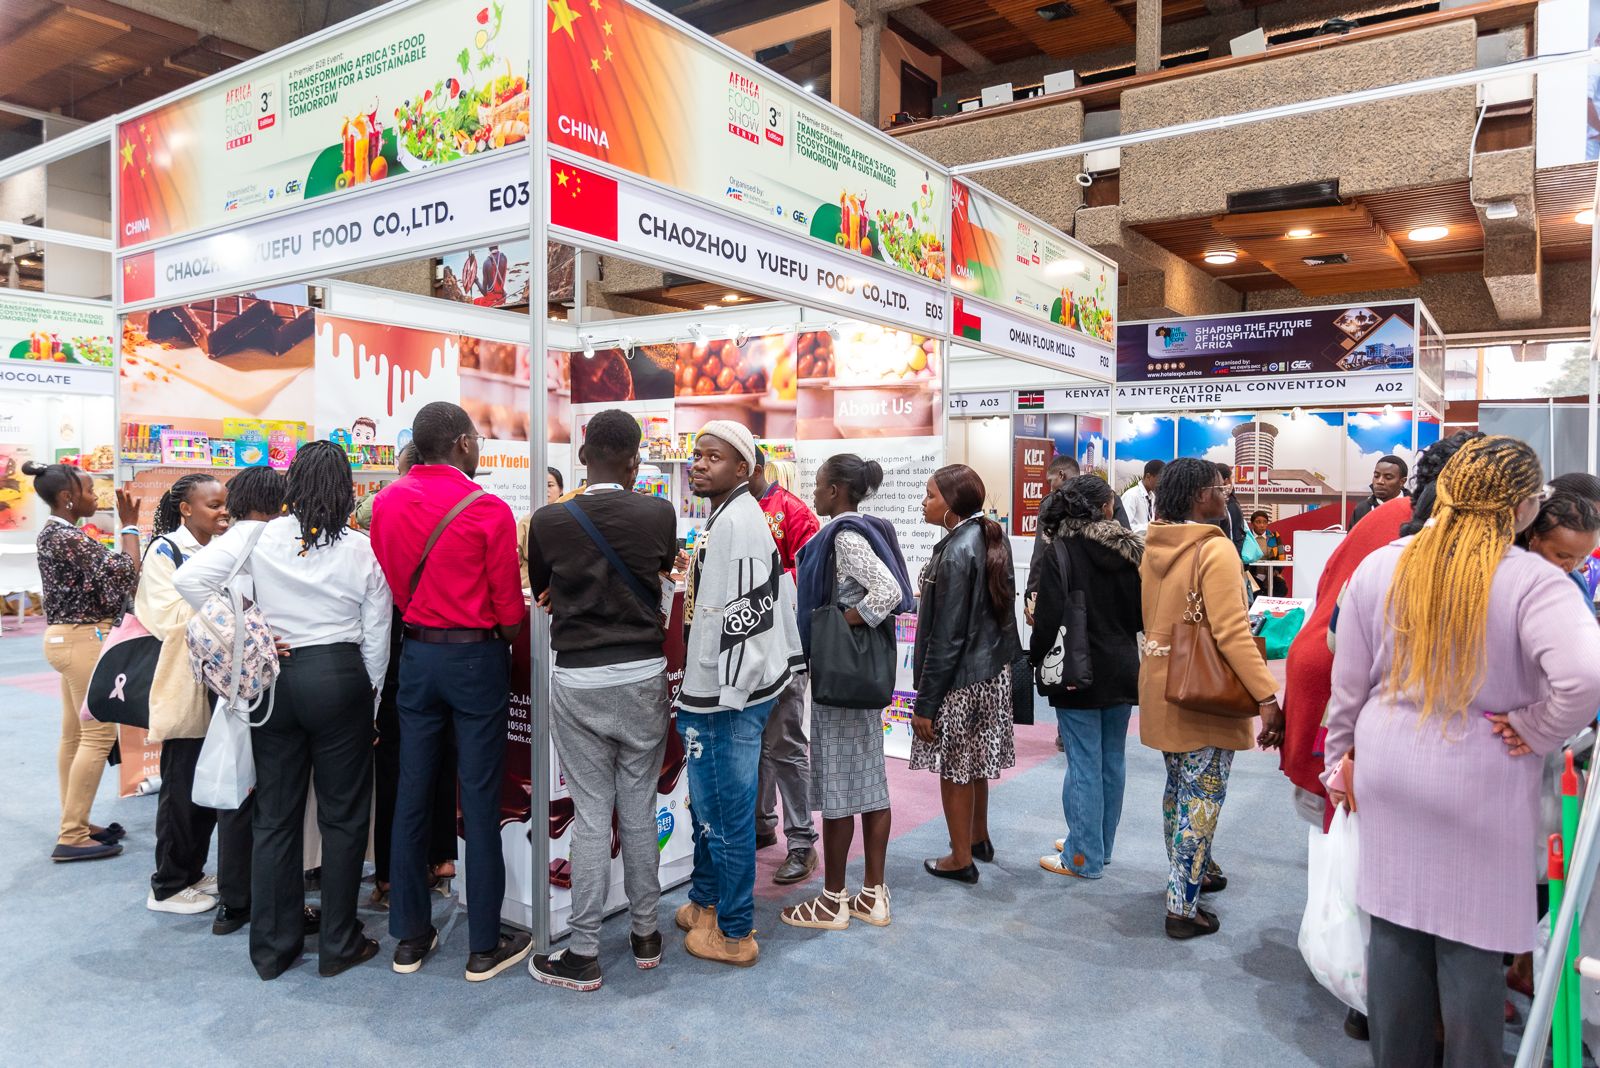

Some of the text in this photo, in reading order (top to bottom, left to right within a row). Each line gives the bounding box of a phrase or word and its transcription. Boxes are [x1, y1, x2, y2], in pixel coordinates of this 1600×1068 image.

[288, 33, 426, 94] TRANSFORMING AFRICA'S FOOD
[288, 46, 427, 107] ECOSYSTEM FOR A SUSTAINABLE
[729, 71, 760, 99] AFRICA
[226, 83, 252, 105] AFRICA
[728, 88, 760, 116] FOOD
[288, 92, 339, 118] TOMORROW
[728, 106, 760, 133] SHOW
[557, 114, 610, 150] CHINA
[729, 123, 760, 145] KENYA
[796, 120, 896, 178] TRANSFORMING AFRICA'S FOOD
[796, 144, 839, 172] TOMORROW
[796, 133, 897, 188] ECOSYSTEM FOR A SUSTAINABLE
[312, 220, 362, 252] FOOD
[373, 200, 454, 236] CO.,LTD.
[489, 180, 530, 213] E03
[125, 217, 151, 236] CHINA
[638, 213, 944, 321] CHAOZHOU YUEFU FOOD CO.,LTD. E03
[956, 264, 975, 278] OMAN
[59, 315, 104, 325] SUSTAINABLE
[1195, 319, 1312, 335] SHAPING THE FUTURE
[1009, 328, 1076, 358] OMAN FLOUR MILLS
[1195, 328, 1294, 343] OF HOSPITALITY IN
[1195, 341, 1233, 350] AFRICA
[1100, 356, 1109, 368] F02
[1214, 359, 1241, 367] Organised
[0, 371, 71, 385] HOCOLATE
[1375, 382, 1403, 393] A02
[1065, 379, 1346, 400] KENYATA INTERNATIONAL CONVENTION
[1170, 393, 1222, 404] CENTRE
[839, 398, 913, 417] About Us
[949, 398, 999, 408] LTD A03
[500, 454, 529, 469] Yuefu
[800, 456, 817, 464] After
[1024, 448, 1045, 466] KICC
[1023, 481, 1044, 499] KICC
[873, 504, 905, 514] including
[911, 530, 936, 539] deeply
